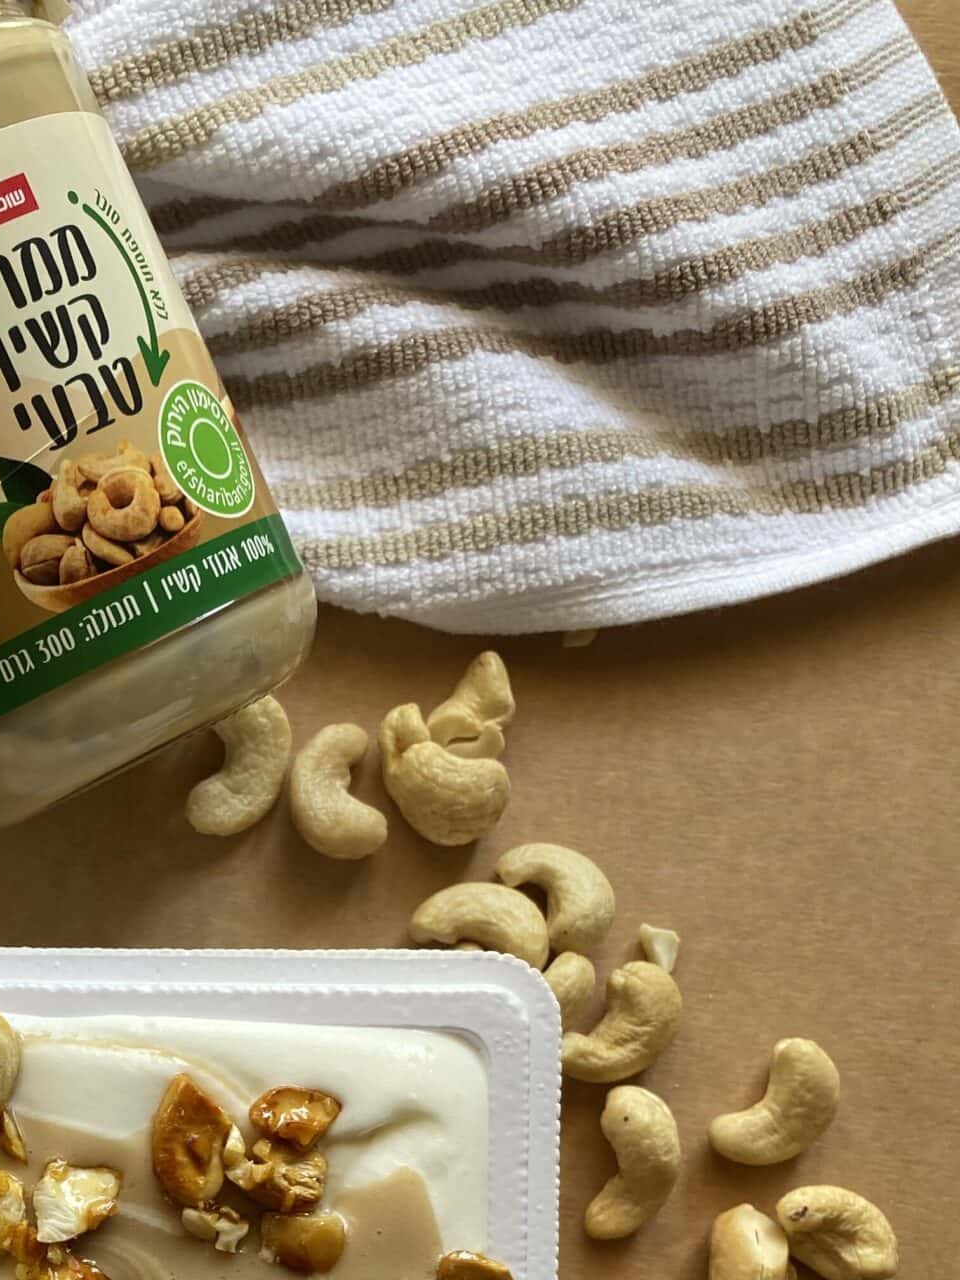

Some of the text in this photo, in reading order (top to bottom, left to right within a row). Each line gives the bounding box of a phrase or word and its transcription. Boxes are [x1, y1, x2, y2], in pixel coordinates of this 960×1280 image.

[94, 188, 169, 320] ללא תוספת סוכר
[13, 357, 143, 451] טבעי
[167, 389, 230, 449] הסימון הירוק
[202, 545, 242, 578] אגוזי
[240, 533, 275, 562] 100%
[160, 564, 203, 601] קשיו
[78, 594, 141, 642] תכולה:
[35, 627, 75, 664] 300
